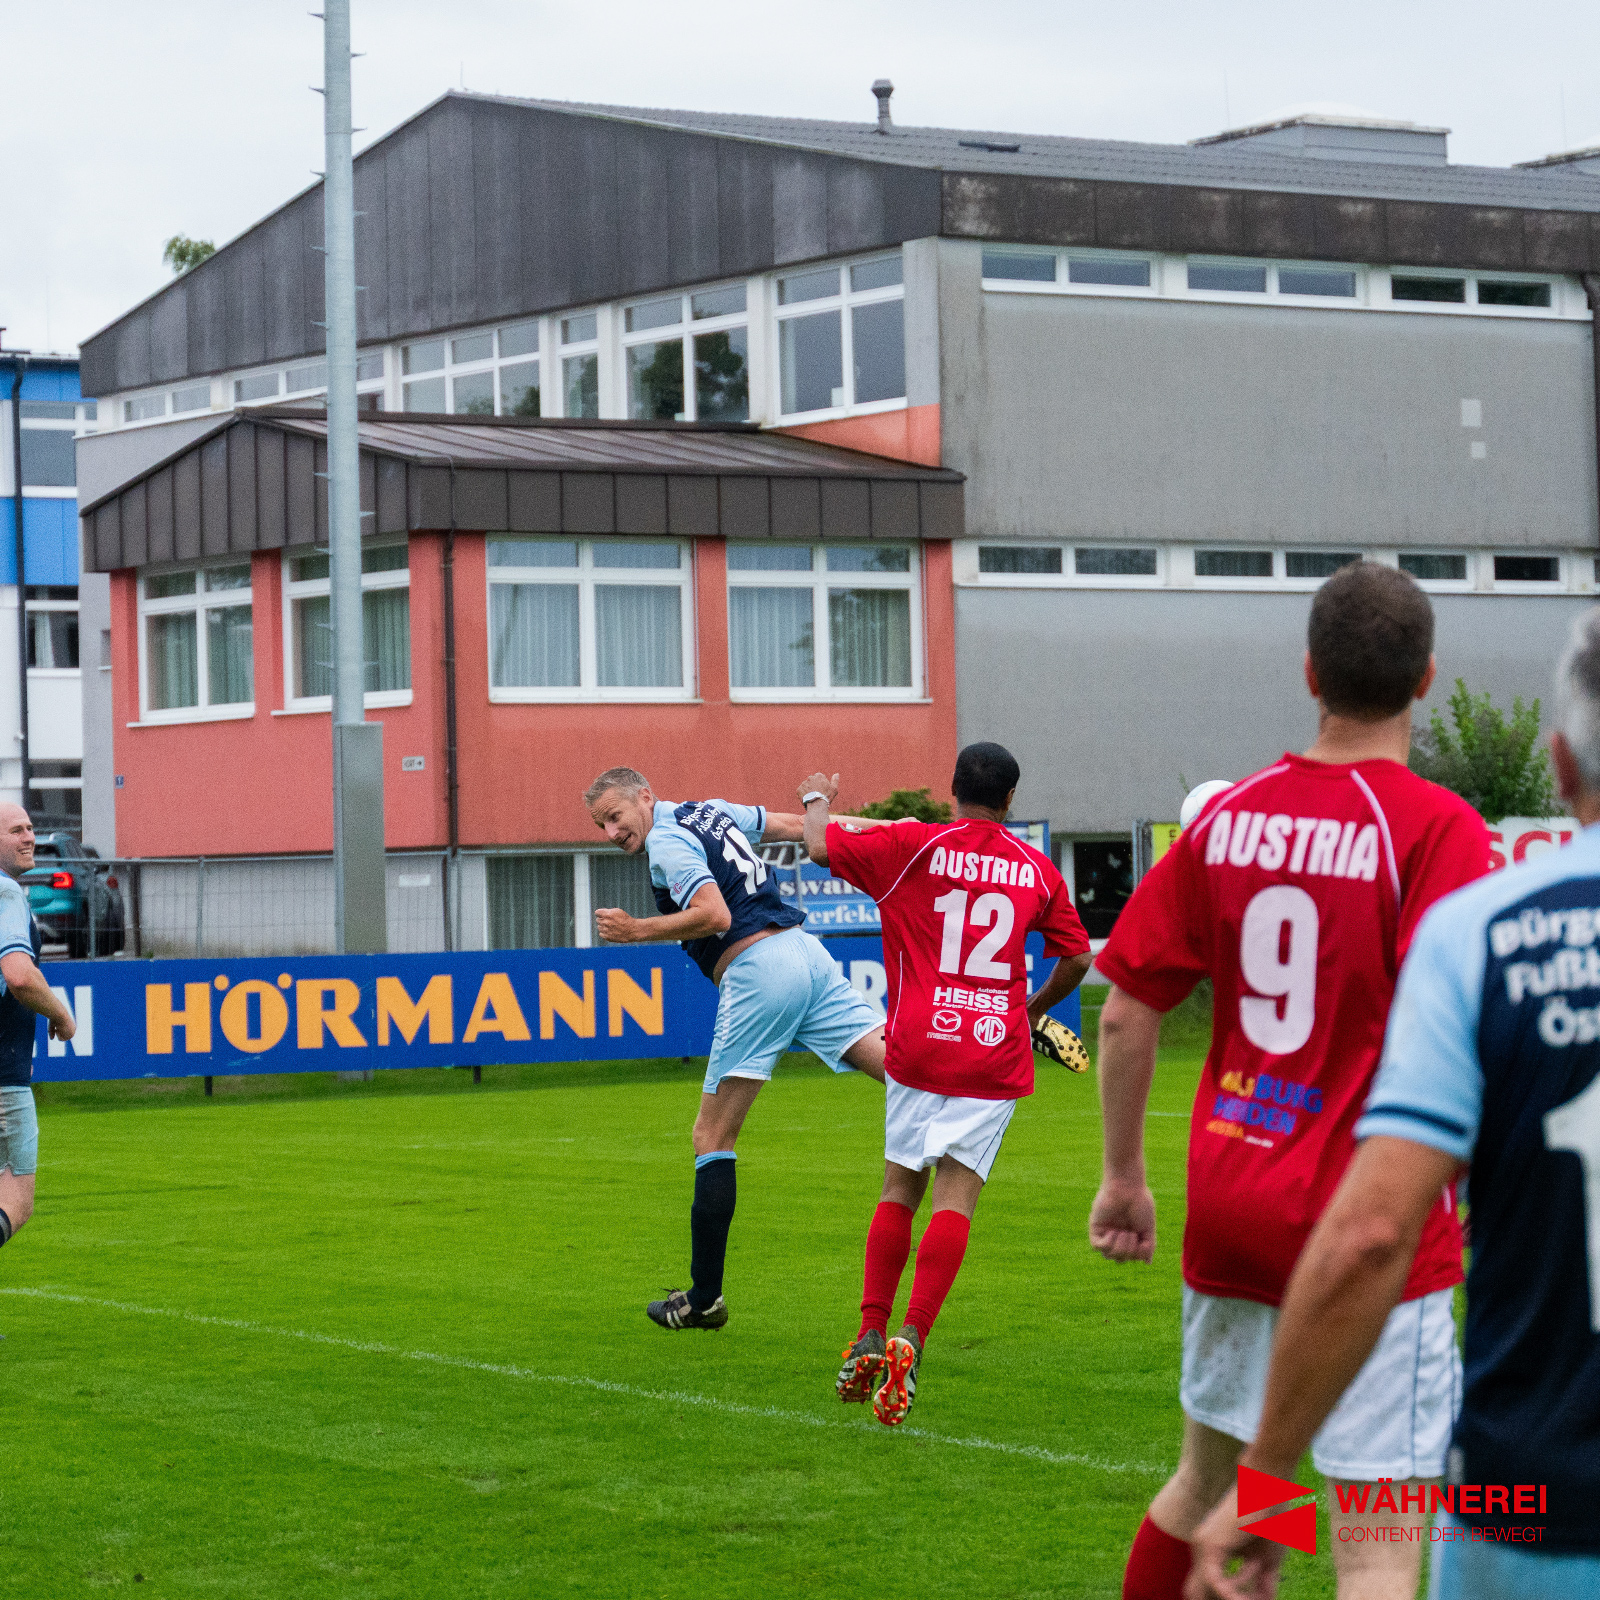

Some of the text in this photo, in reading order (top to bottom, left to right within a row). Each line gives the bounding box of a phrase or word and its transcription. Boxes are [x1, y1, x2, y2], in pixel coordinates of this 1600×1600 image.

[929, 846, 1035, 888] AUSTRIA
[1205, 810, 1379, 882] AUSTRIA
[933, 888, 1015, 981] 12
[1239, 884, 1319, 1055] 9
[145, 967, 664, 1055] HÖRMANN
[977, 987, 1009, 995] Autohaus
[976, 1018, 1003, 1043] MG
